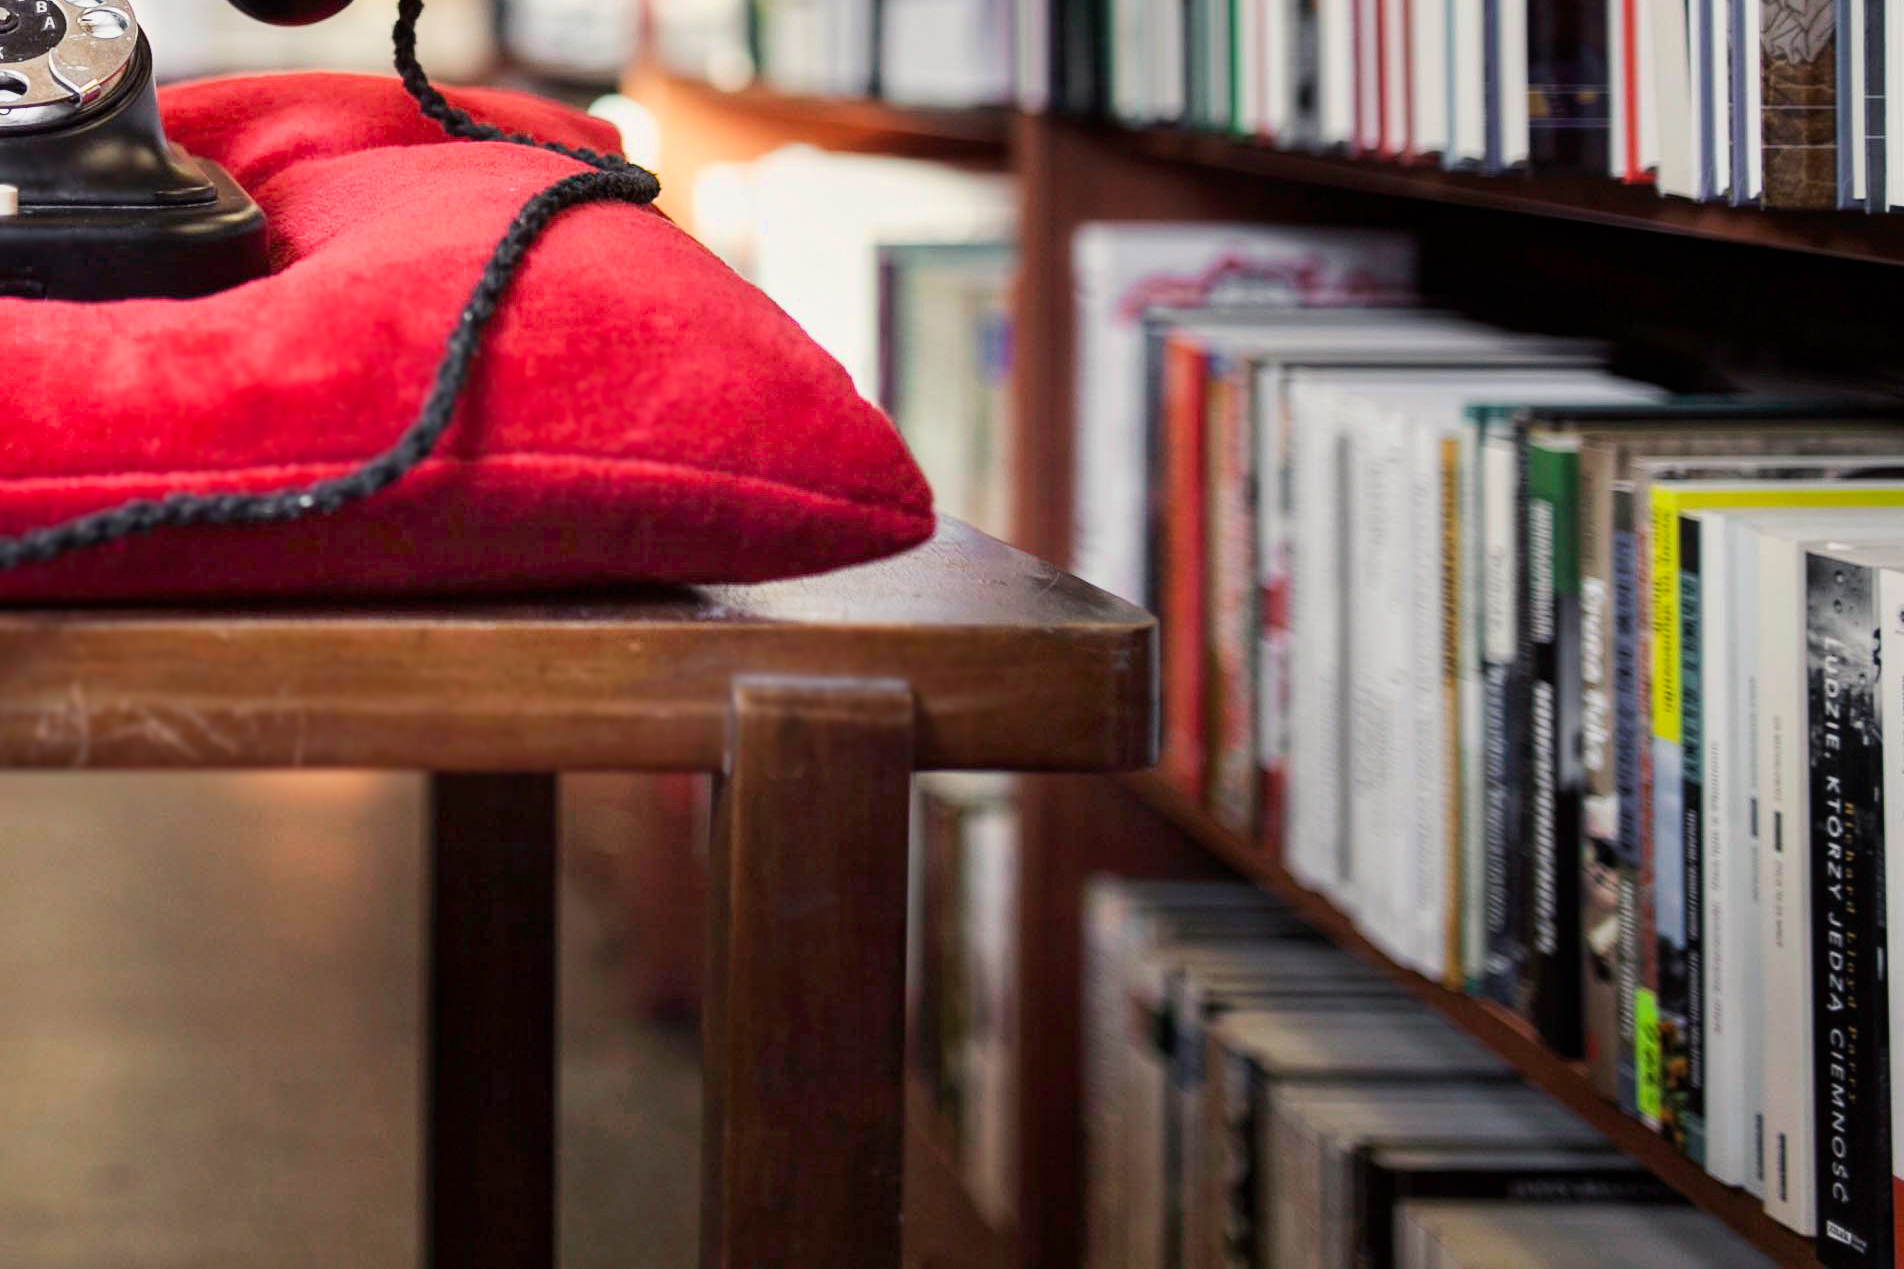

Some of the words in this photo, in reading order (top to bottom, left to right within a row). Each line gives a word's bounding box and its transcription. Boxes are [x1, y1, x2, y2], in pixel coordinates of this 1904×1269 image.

[36, 1, 48, 13] B
[44, 17, 56, 30] A
[1824, 636, 1841, 759] LUDZIE,
[1825, 774, 1842, 901] KTÓRZY
[1844, 802, 1857, 914] Richard
[1826, 911, 1844, 1011] JEDZĄ
[1846, 931, 1858, 1009] Lloyd
[1829, 1028, 1849, 1204] CIEMNOŚĆ
